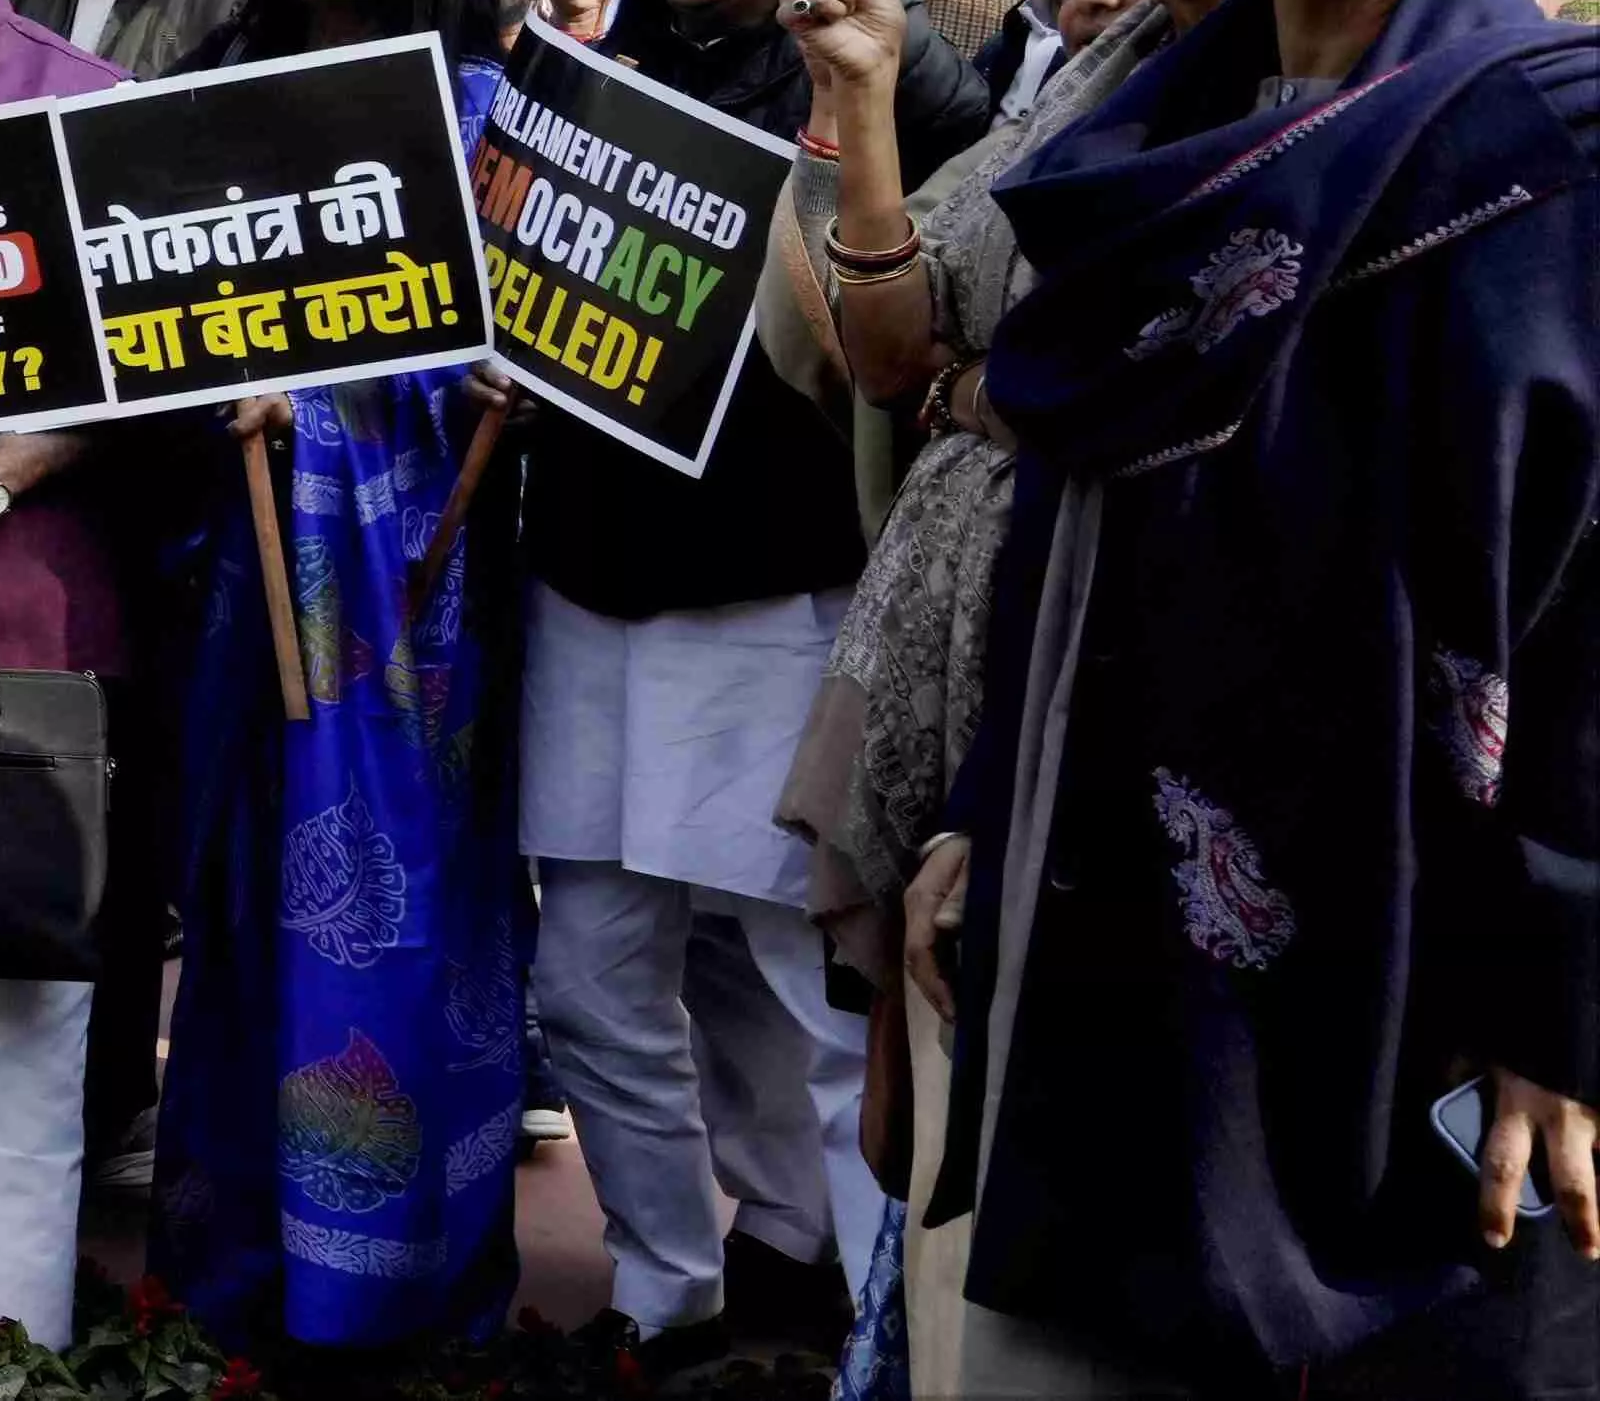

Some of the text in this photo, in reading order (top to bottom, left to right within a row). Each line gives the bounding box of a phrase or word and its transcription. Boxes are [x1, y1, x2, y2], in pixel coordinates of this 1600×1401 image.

[308, 160, 405, 246] की
[490, 75, 747, 251] ARLIAMENT CAGED
[190, 280, 287, 359] बंद
[293, 251, 459, 343] करो!
